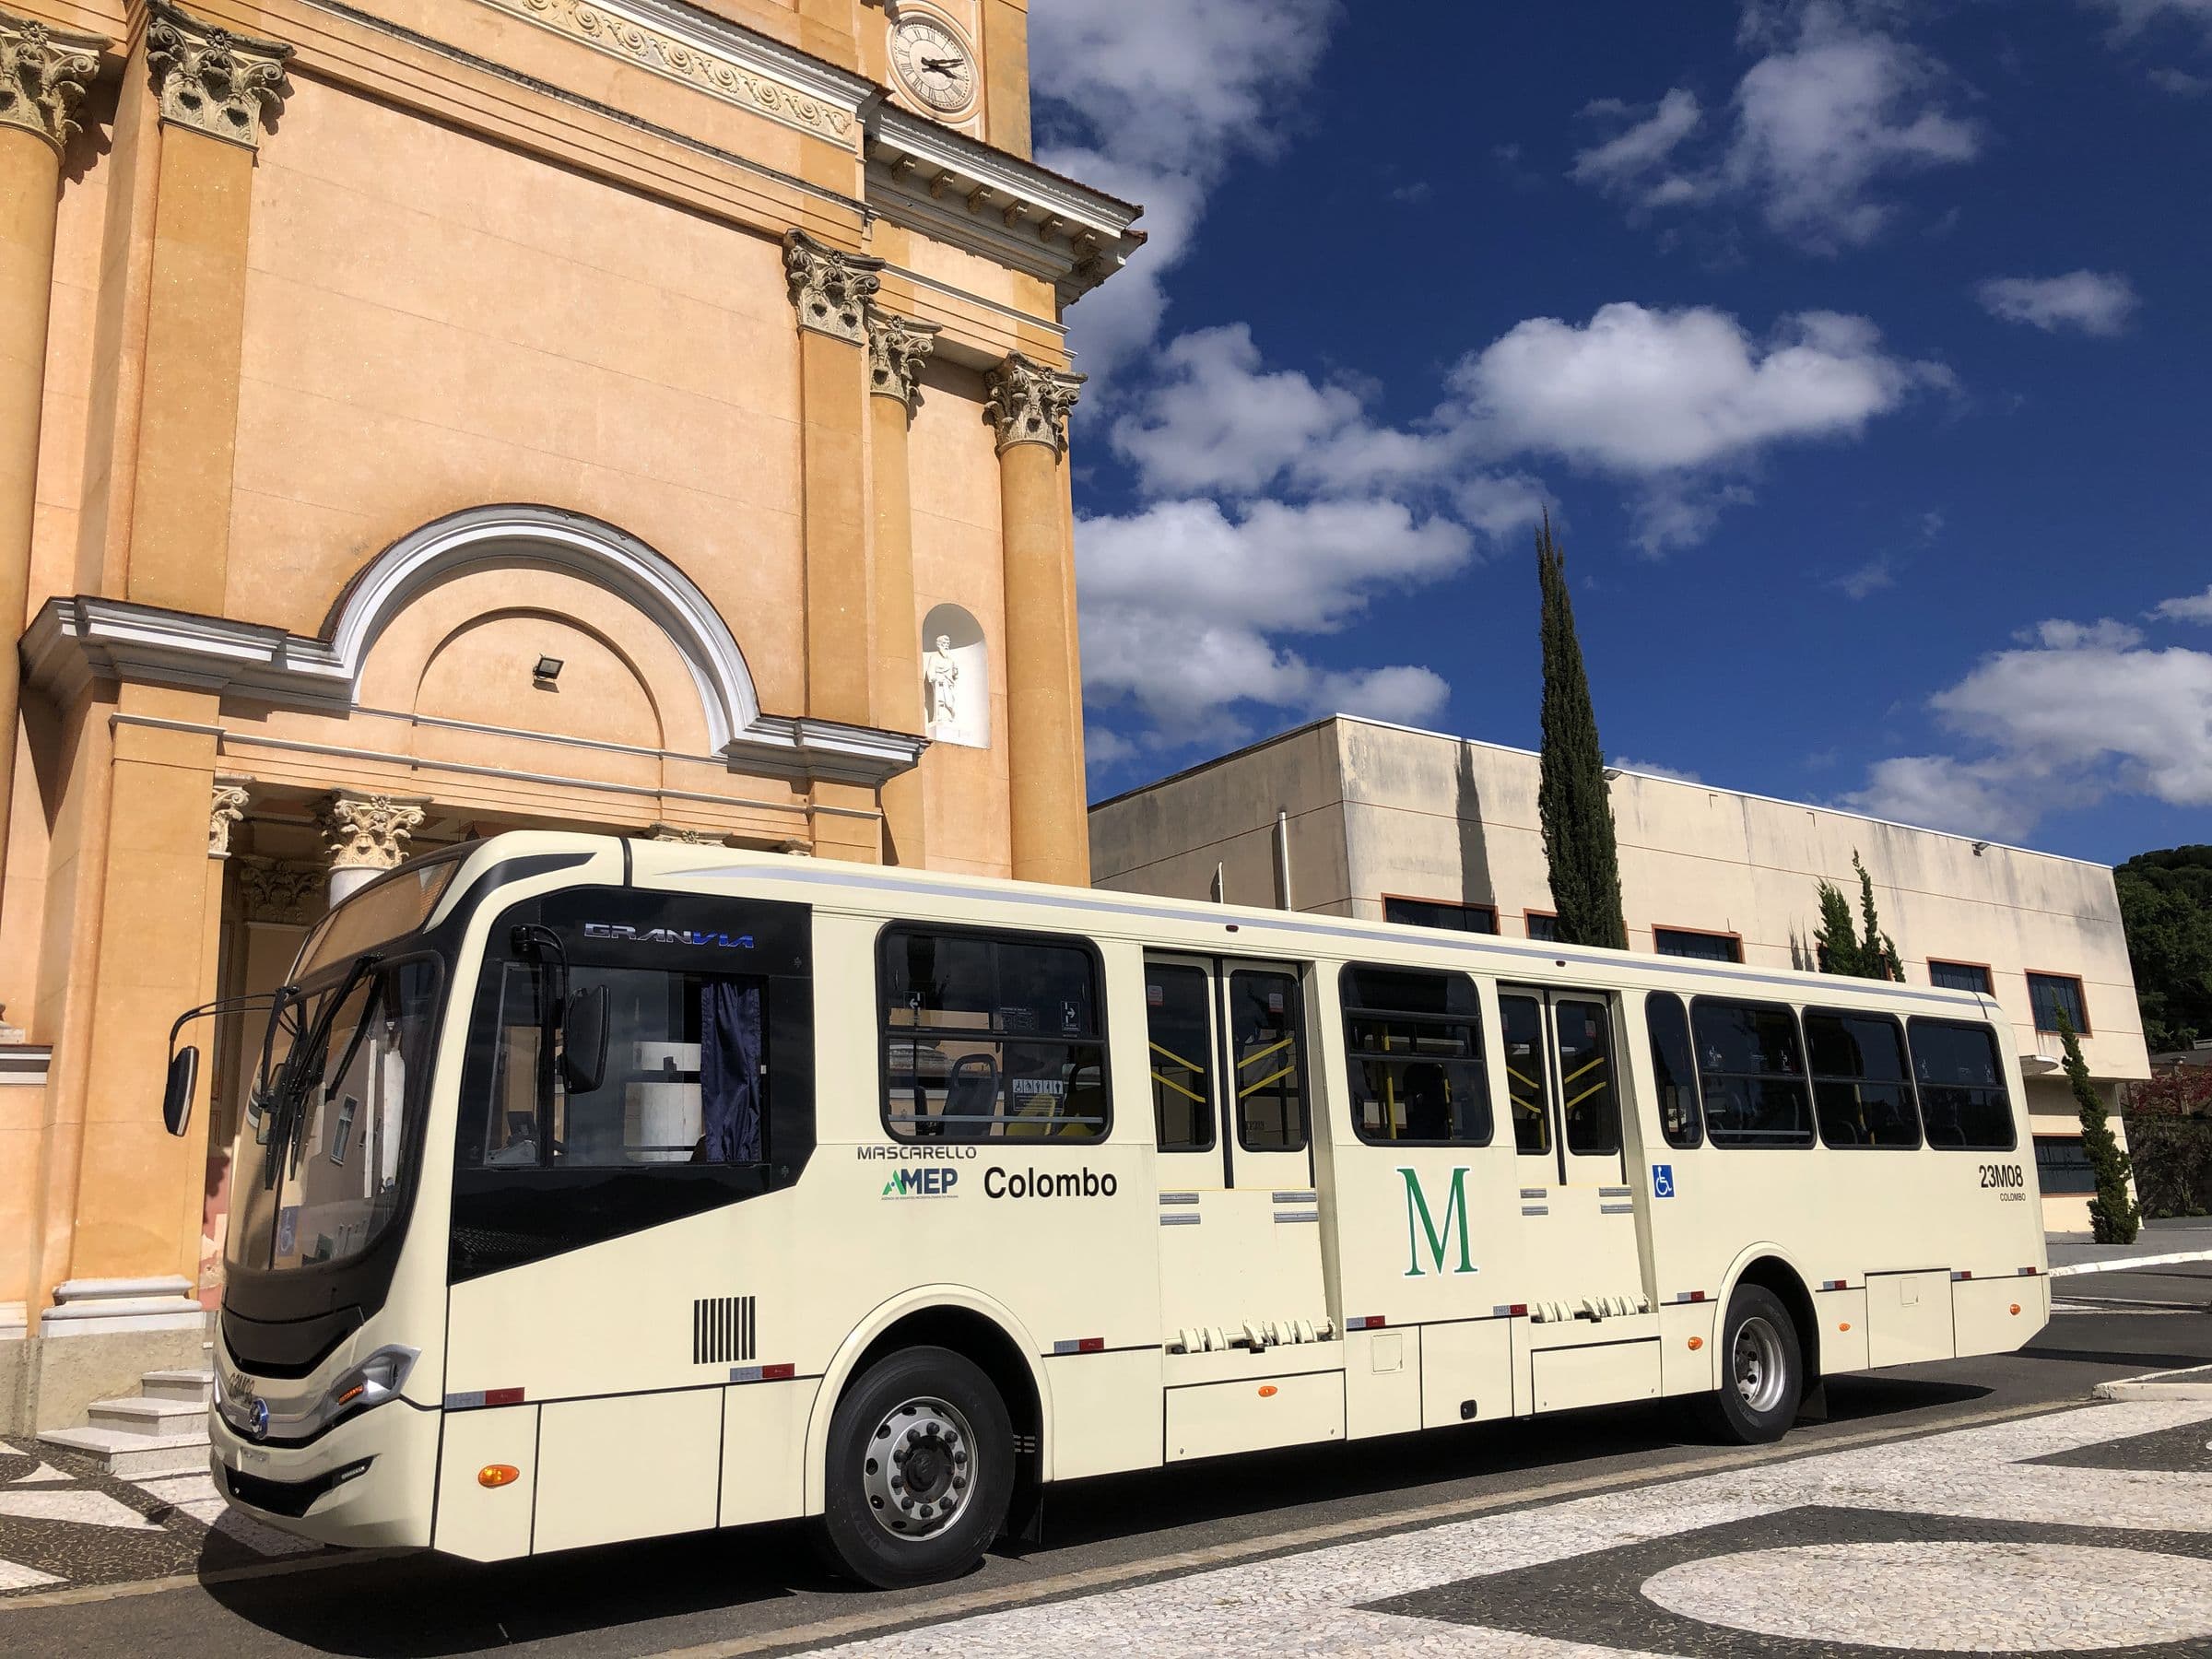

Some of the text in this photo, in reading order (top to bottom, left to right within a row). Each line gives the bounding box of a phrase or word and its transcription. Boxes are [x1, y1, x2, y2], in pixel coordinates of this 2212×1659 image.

[583, 923, 755, 948] GRANVIA
[857, 1146, 977, 1159] MASCARELLO
[882, 1168, 959, 1195] AMEP
[983, 1166, 1117, 1198] Colombo
[1979, 1164, 2024, 1188] 23M08
[1999, 1193, 2027, 1202] COLOMBO
[1395, 1167, 1478, 1276] M
